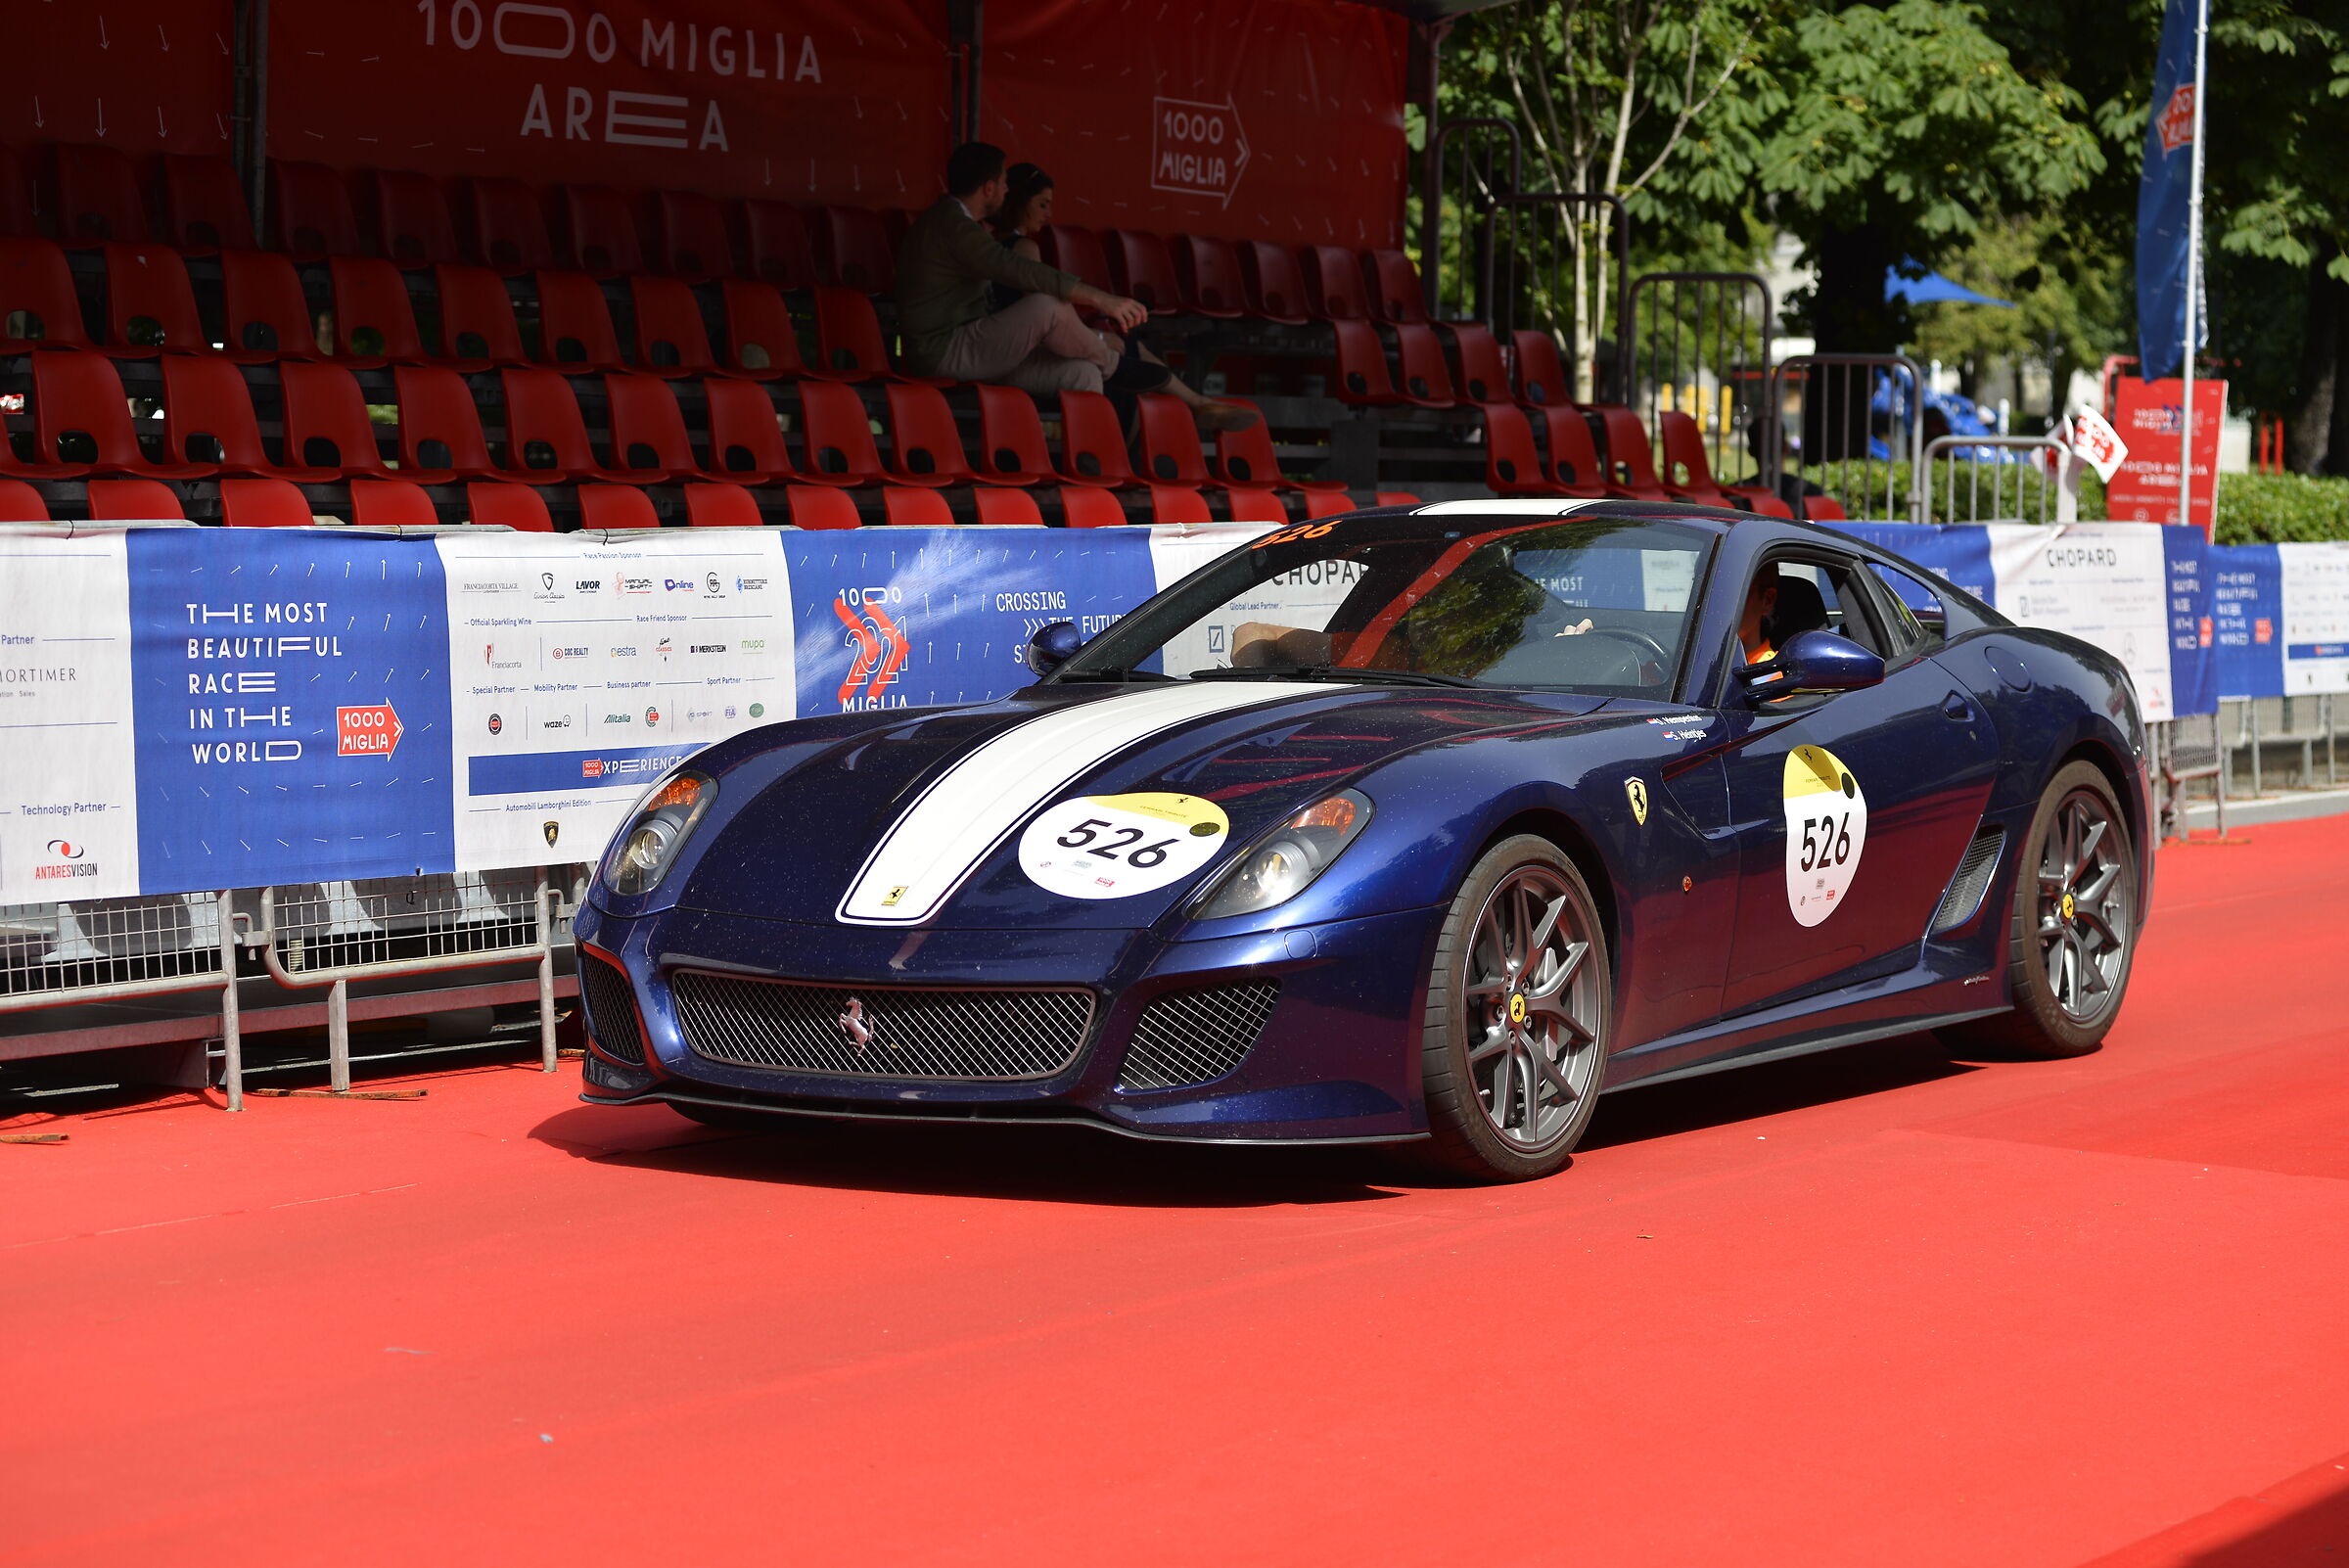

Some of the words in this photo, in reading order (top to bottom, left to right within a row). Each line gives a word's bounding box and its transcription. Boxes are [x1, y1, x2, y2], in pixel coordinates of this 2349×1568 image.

[417, 0, 617, 64] 1000
[640, 19, 822, 84] MIGLIA
[520, 83, 729, 153] AREA
[1163, 110, 1224, 145] 1000
[1159, 151, 1226, 186] MIGLIA
[1252, 520, 1343, 550] 526
[2047, 548, 2117, 568] CHOPARD
[576, 580, 601, 590] LAVOR
[1550, 576, 1584, 591] MOST
[839, 586, 901, 606] 1000
[996, 591, 1067, 612] CROSSING
[186, 603, 253, 624] THE
[265, 602, 328, 623] MOST
[1229, 602, 1247, 611] Global
[491, 618, 518, 627] Sparkling
[667, 615, 687, 623] Sponsor
[1082, 614, 1127, 634] FUTU
[1, 634, 35, 645] Partner
[187, 636, 343, 659] BEAUTIFUL
[741, 639, 764, 651] mupa
[491, 661, 523, 669] Franciacorta
[0, 668, 76, 683] ORTIMER
[188, 671, 277, 694] RACE
[707, 677, 721, 686] Sport
[721, 676, 741, 685] Partner
[472, 685, 492, 695] Special
[493, 685, 516, 694] Partner
[533, 684, 556, 693] Mobility
[557, 683, 578, 692] Partner
[630, 680, 651, 689] partner
[190, 708, 213, 729] IN
[224, 706, 292, 728] THE
[344, 712, 386, 728] 1000
[603, 714, 631, 724] Alitalia
[342, 733, 389, 751] MIGLIA
[192, 740, 302, 764] WORLD
[22, 805, 71, 816] Technology
[73, 803, 107, 813] Partner
[505, 801, 536, 812] Automobili
[537, 800, 572, 810] Lamborghini
[572, 799, 592, 808] Edition
[1056, 818, 1181, 868] 526
[1800, 811, 1851, 873] 526
